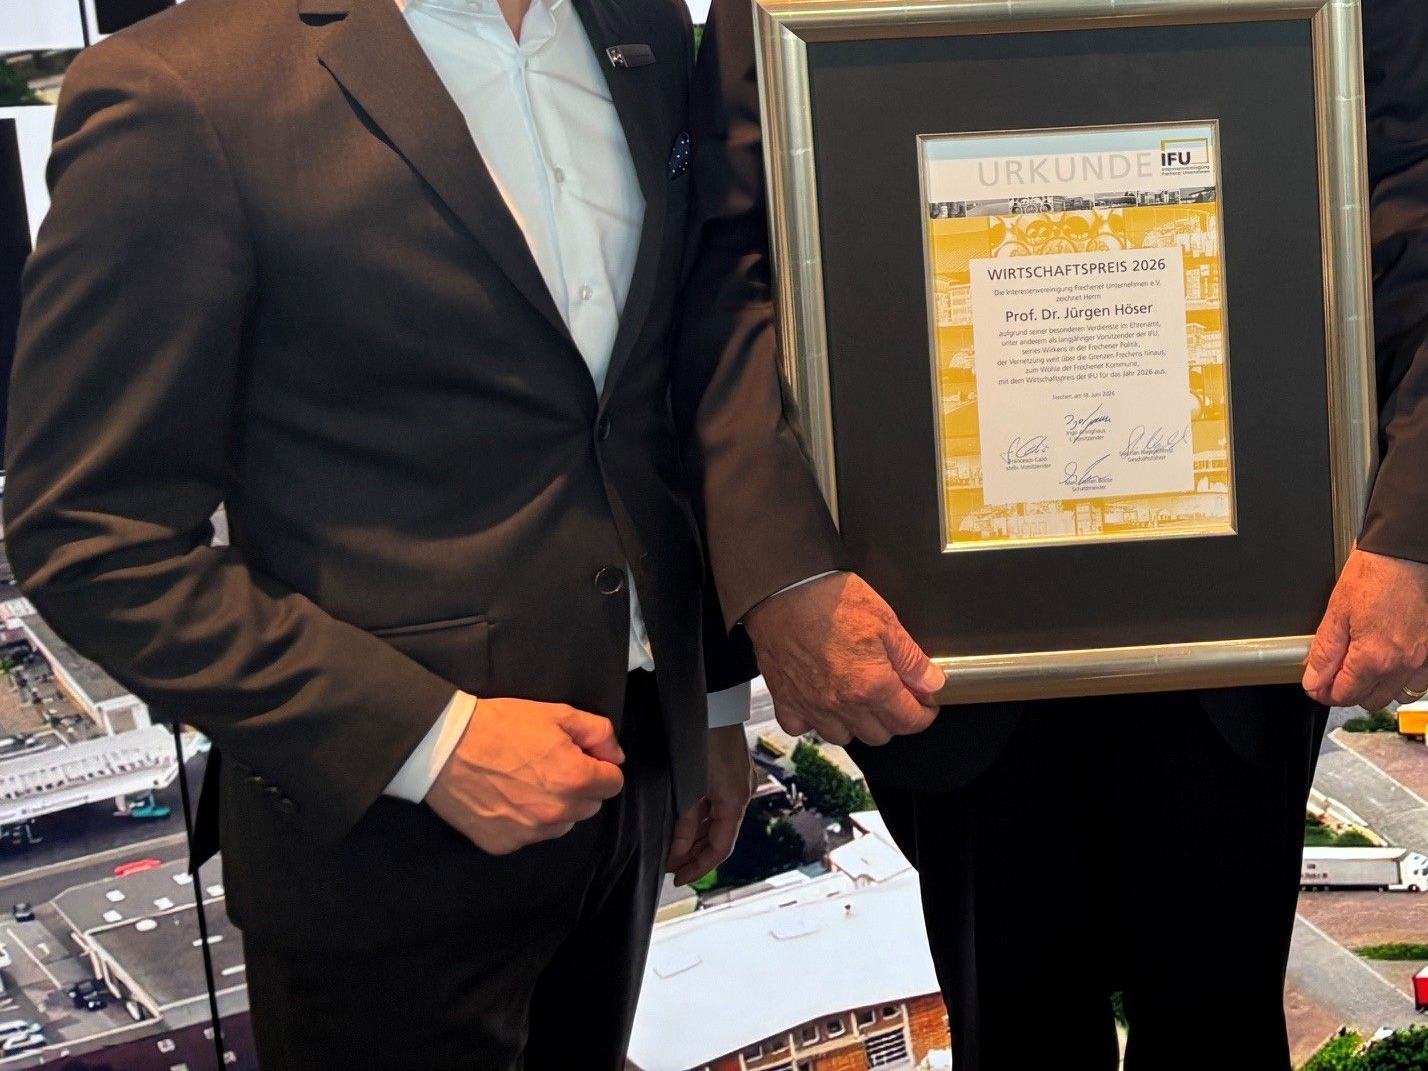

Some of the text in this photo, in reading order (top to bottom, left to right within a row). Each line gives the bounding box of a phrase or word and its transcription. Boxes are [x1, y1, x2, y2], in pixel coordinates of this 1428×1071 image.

[978, 151, 1153, 187] URKUNDE
[1161, 151, 1191, 167] IFU
[987, 258, 1166, 281] WIRTSCHAFTSPREIS 2026
[1005, 302, 1154, 322] Prof. Dr. Jürgen Höser
